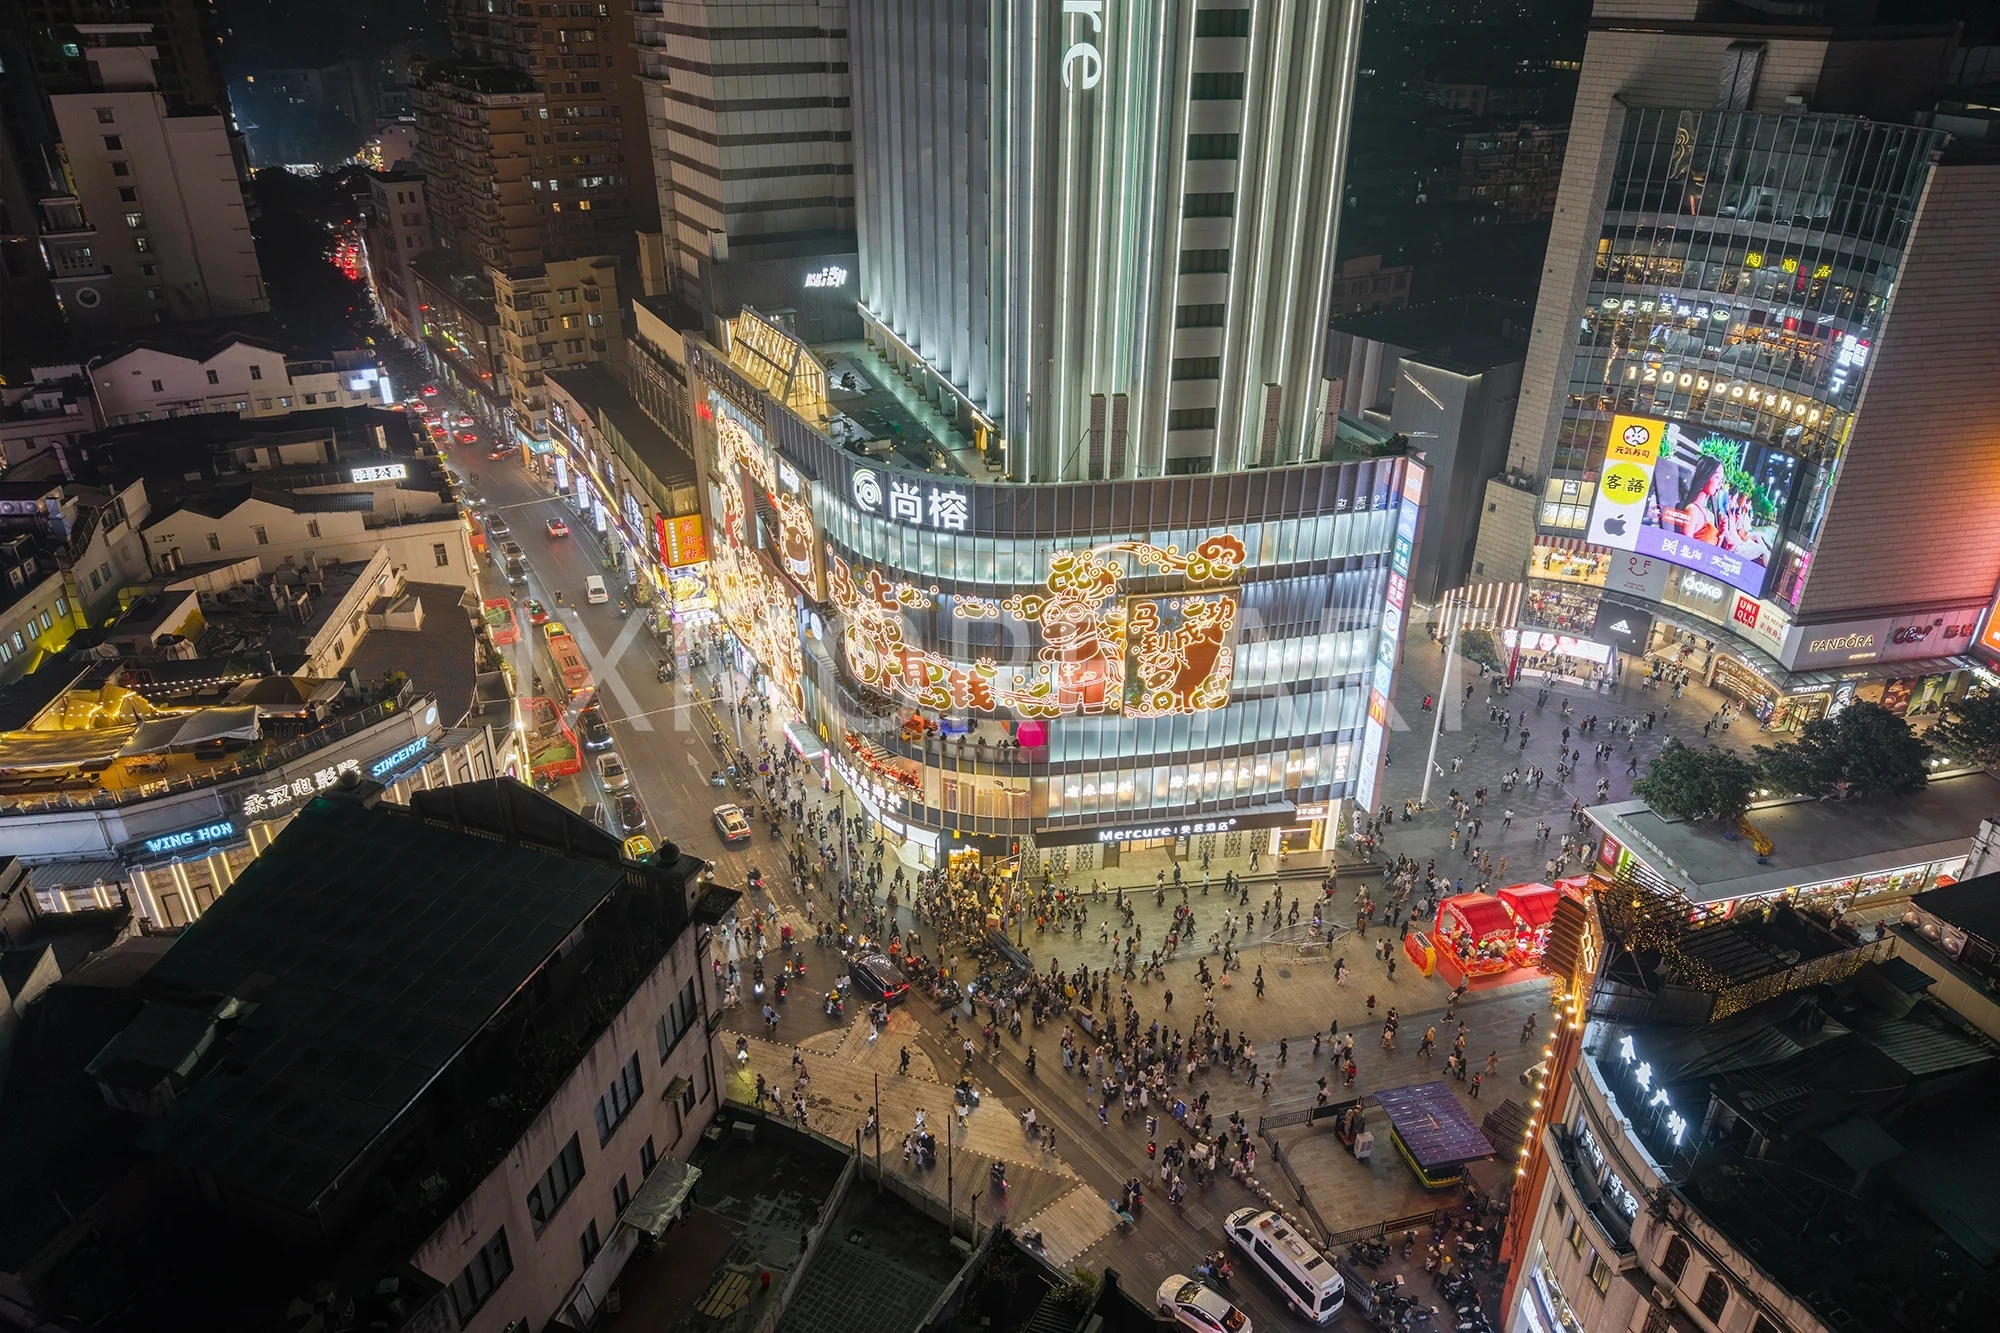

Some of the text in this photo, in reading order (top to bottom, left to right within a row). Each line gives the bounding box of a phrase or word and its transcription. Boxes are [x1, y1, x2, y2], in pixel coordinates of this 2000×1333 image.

[1746, 252, 1832, 279] 陶陶居
[1622, 299, 1710, 319] 萨莉亚臻选
[1627, 365, 1821, 423] 1200bookshop
[889, 481, 968, 531] 尚榕
[1809, 633, 1875, 653] PANDORA
[372, 737, 429, 777] SINCE1927
[145, 821, 233, 852] WING HON
[1099, 820, 1229, 842] Mercure 美居酒店
